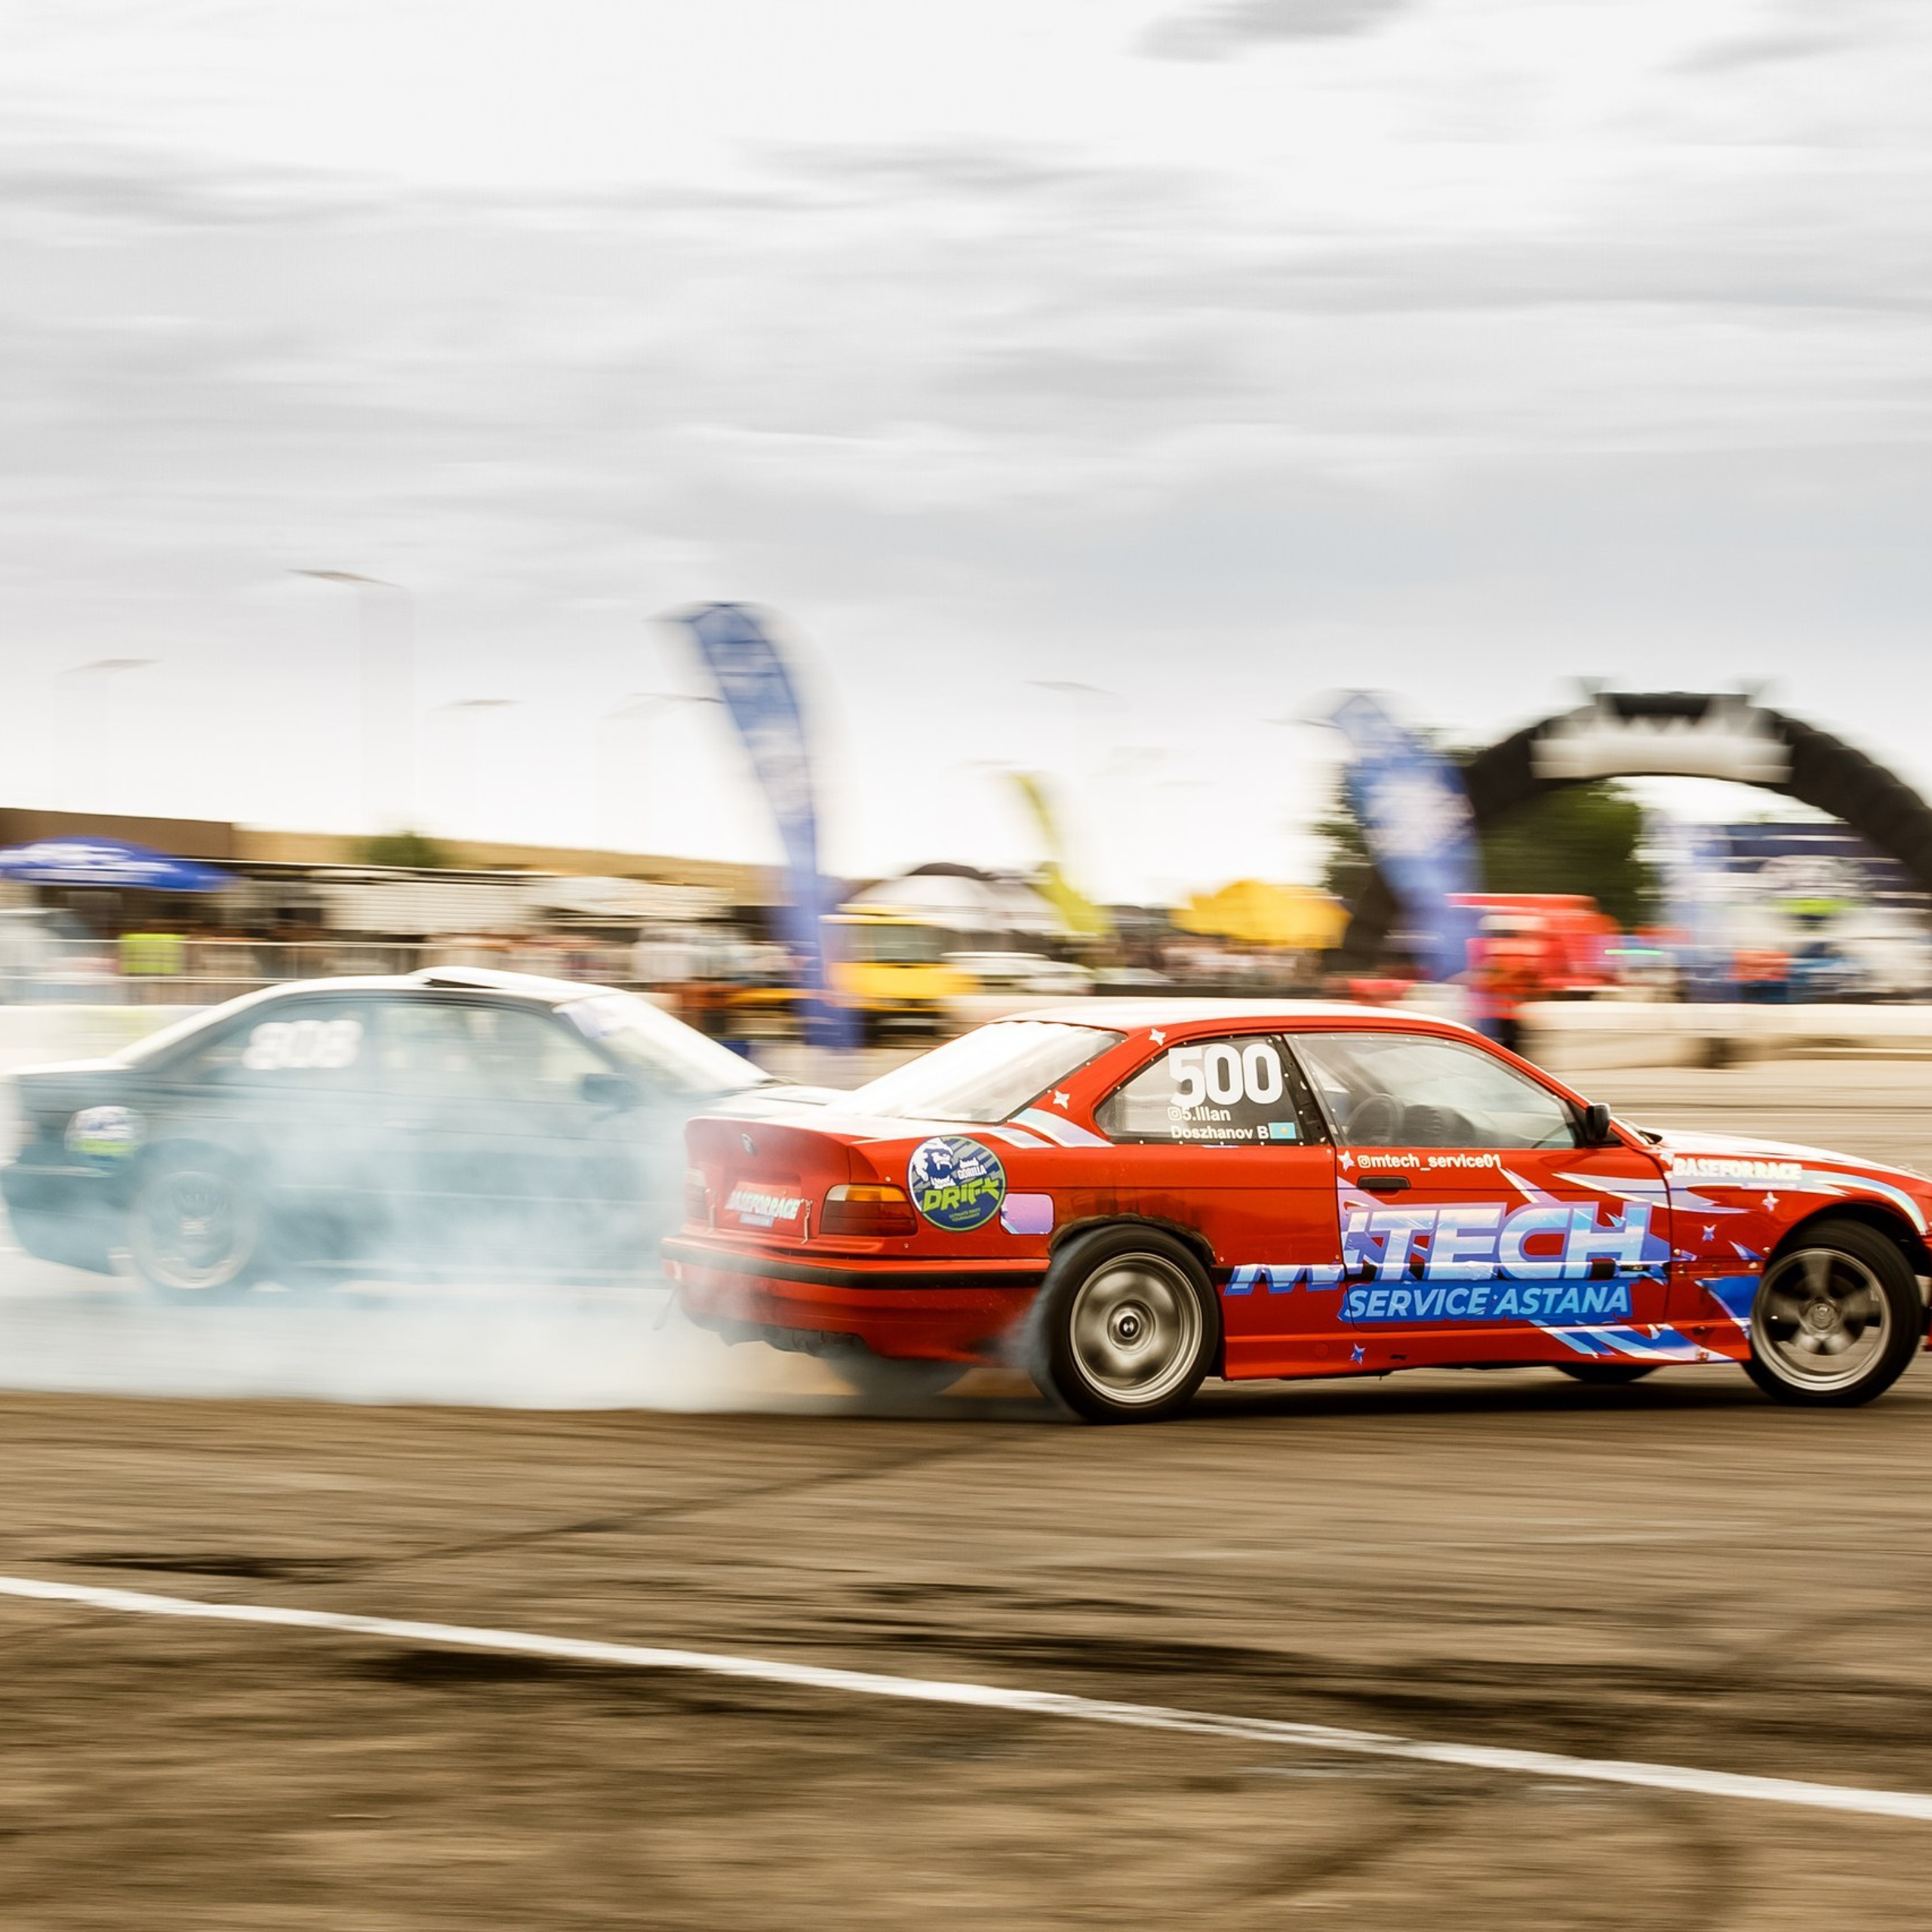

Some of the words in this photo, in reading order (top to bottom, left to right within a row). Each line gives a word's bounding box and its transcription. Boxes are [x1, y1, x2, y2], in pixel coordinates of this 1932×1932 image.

[1168, 1043, 1283, 1106] 500
[1170, 1125, 1254, 1140] Doszhanov
[1257, 1125, 1269, 1140] B
[957, 1164, 987, 1180] GORILLA
[922, 1177, 1000, 1213] DRIFT
[1343, 1287, 1491, 1318] SERVICE
[1492, 1286, 1629, 1316] ASTANA
